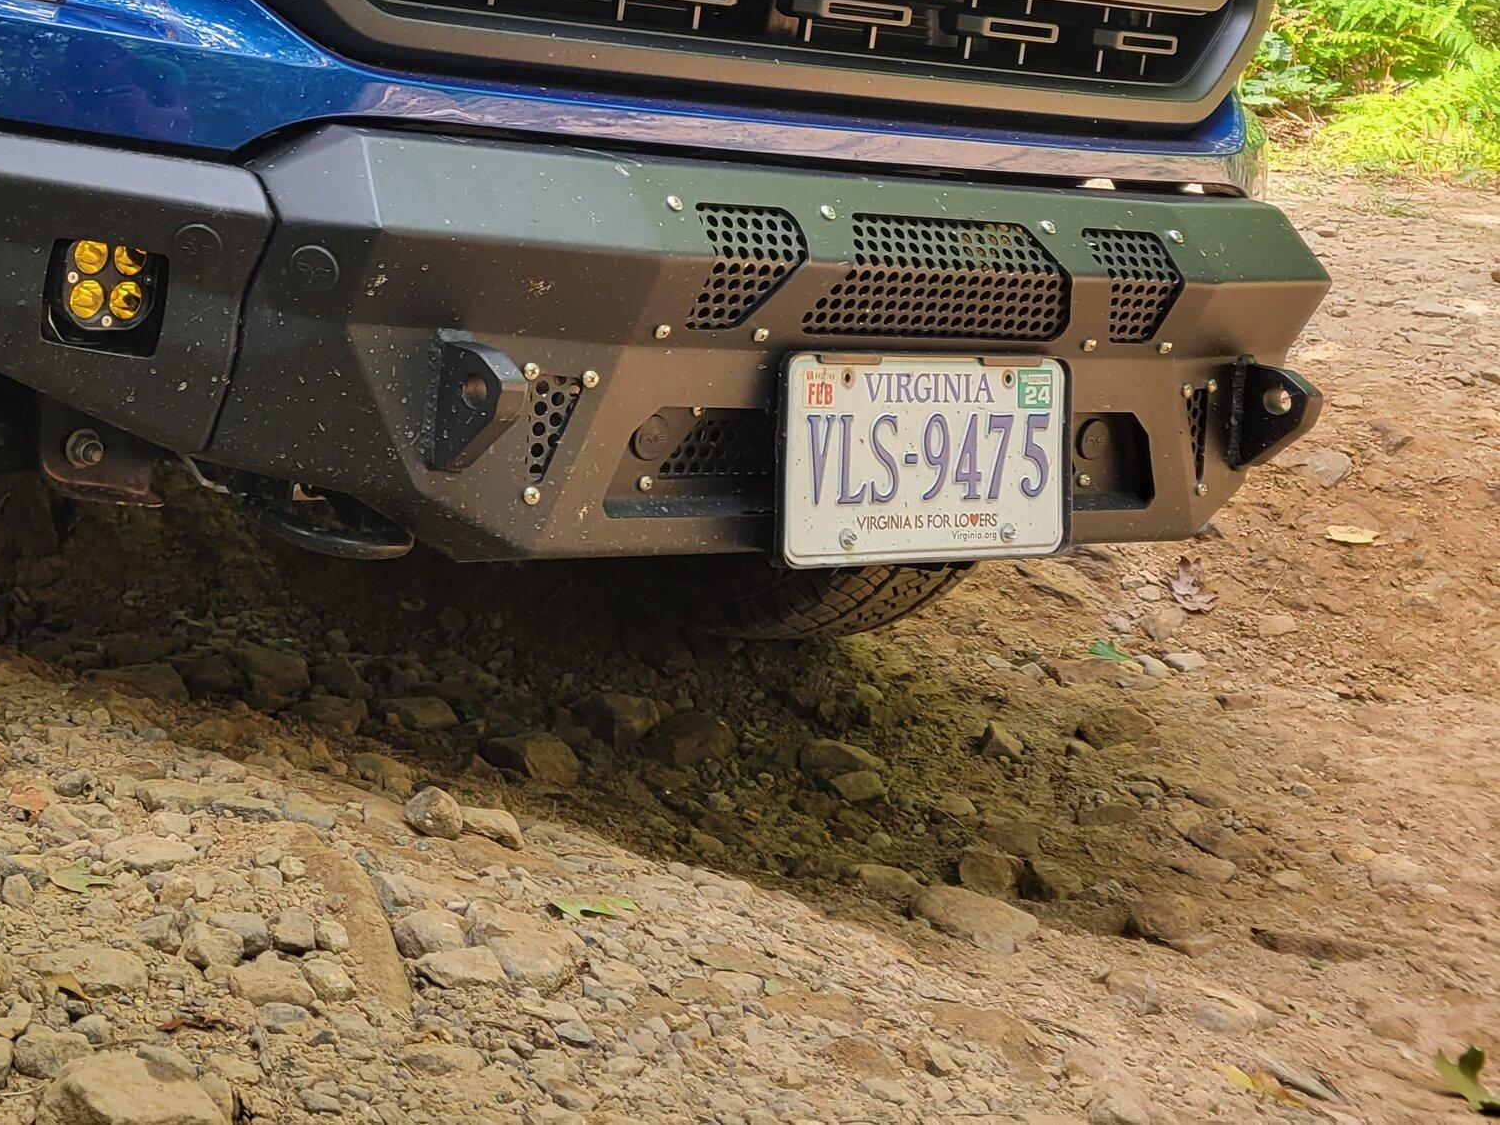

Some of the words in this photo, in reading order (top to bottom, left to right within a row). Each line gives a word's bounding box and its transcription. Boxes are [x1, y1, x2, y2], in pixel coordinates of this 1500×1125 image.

[807, 383, 834, 405] FEB
[864, 372, 995, 404] VIRGINIA
[1024, 385, 1051, 405] 24
[806, 412, 1051, 505] VLS-9475
[856, 514, 912, 531] VIRGINIA
[915, 514, 924, 529] IS
[927, 514, 952, 529] FOR
[951, 530, 997, 542] Virginia.org
